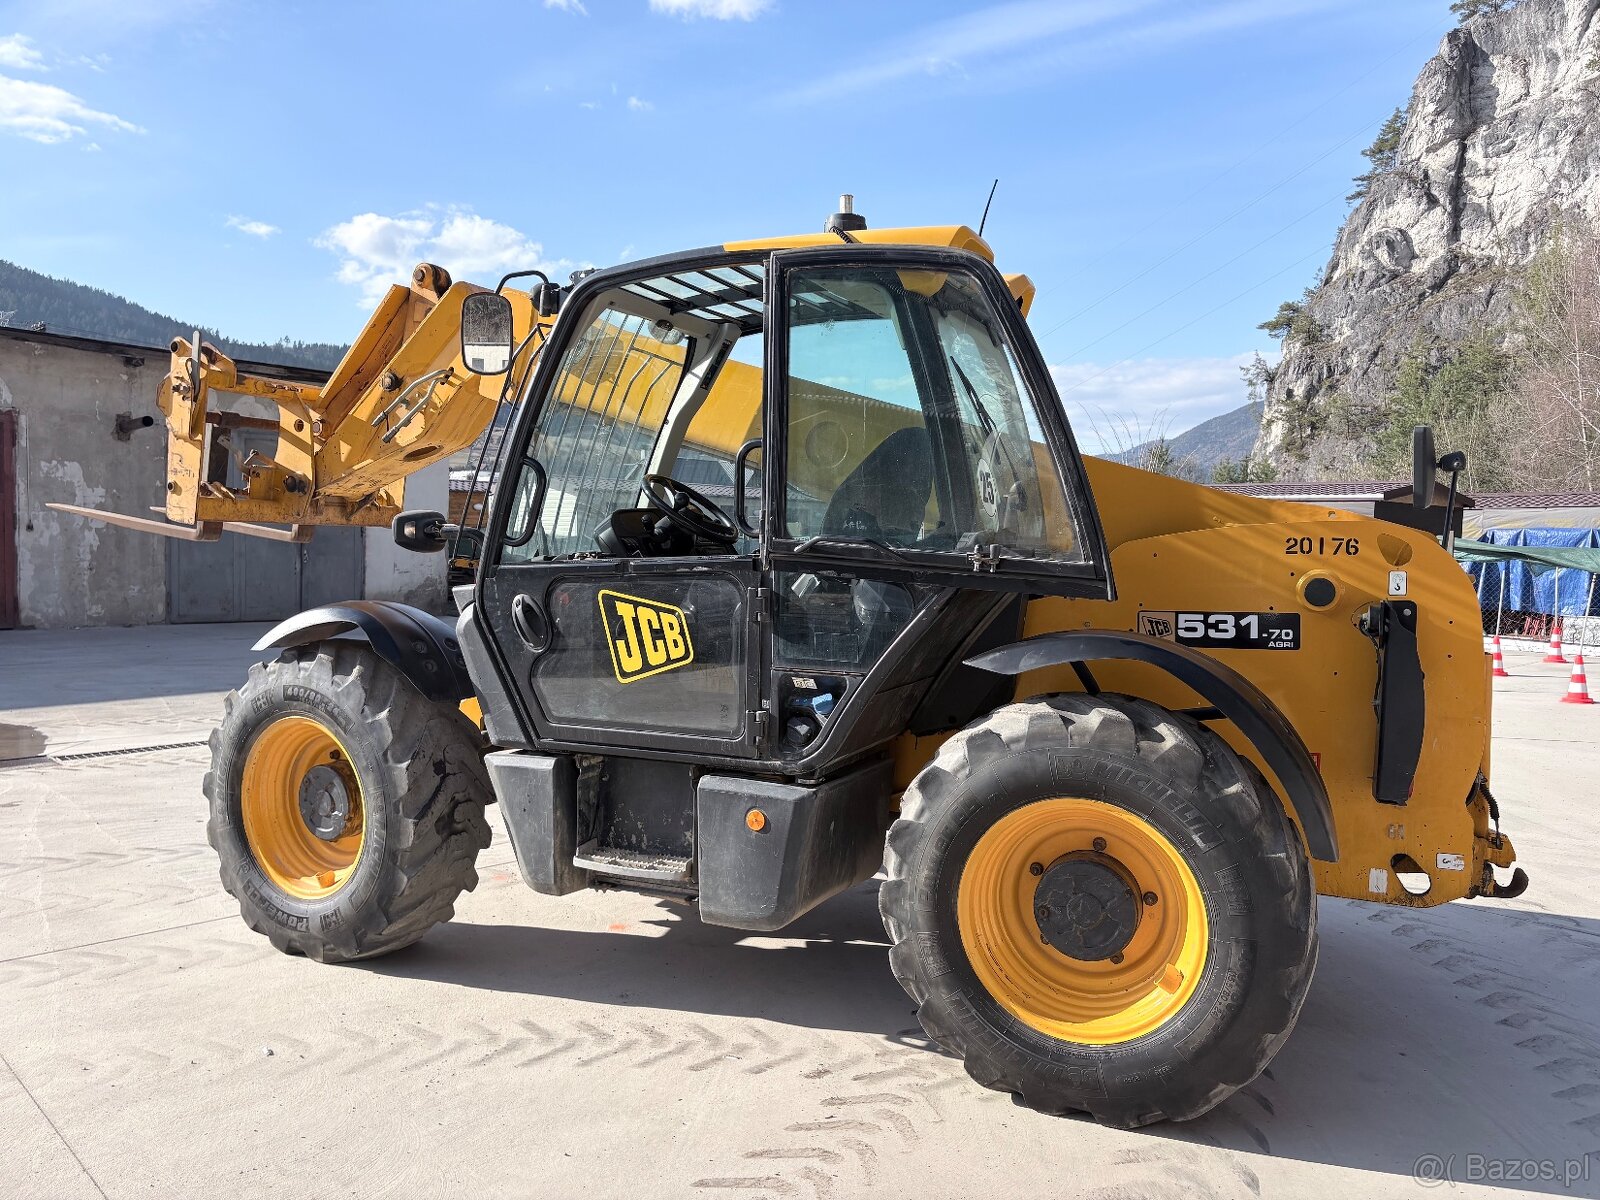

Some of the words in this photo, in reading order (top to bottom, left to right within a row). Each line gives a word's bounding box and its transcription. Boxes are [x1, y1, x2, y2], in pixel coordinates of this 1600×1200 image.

[979, 471, 995, 505] 25
[1285, 537, 1359, 555] 20176
[614, 600, 686, 673] JCB
[1147, 616, 1170, 637] JCB
